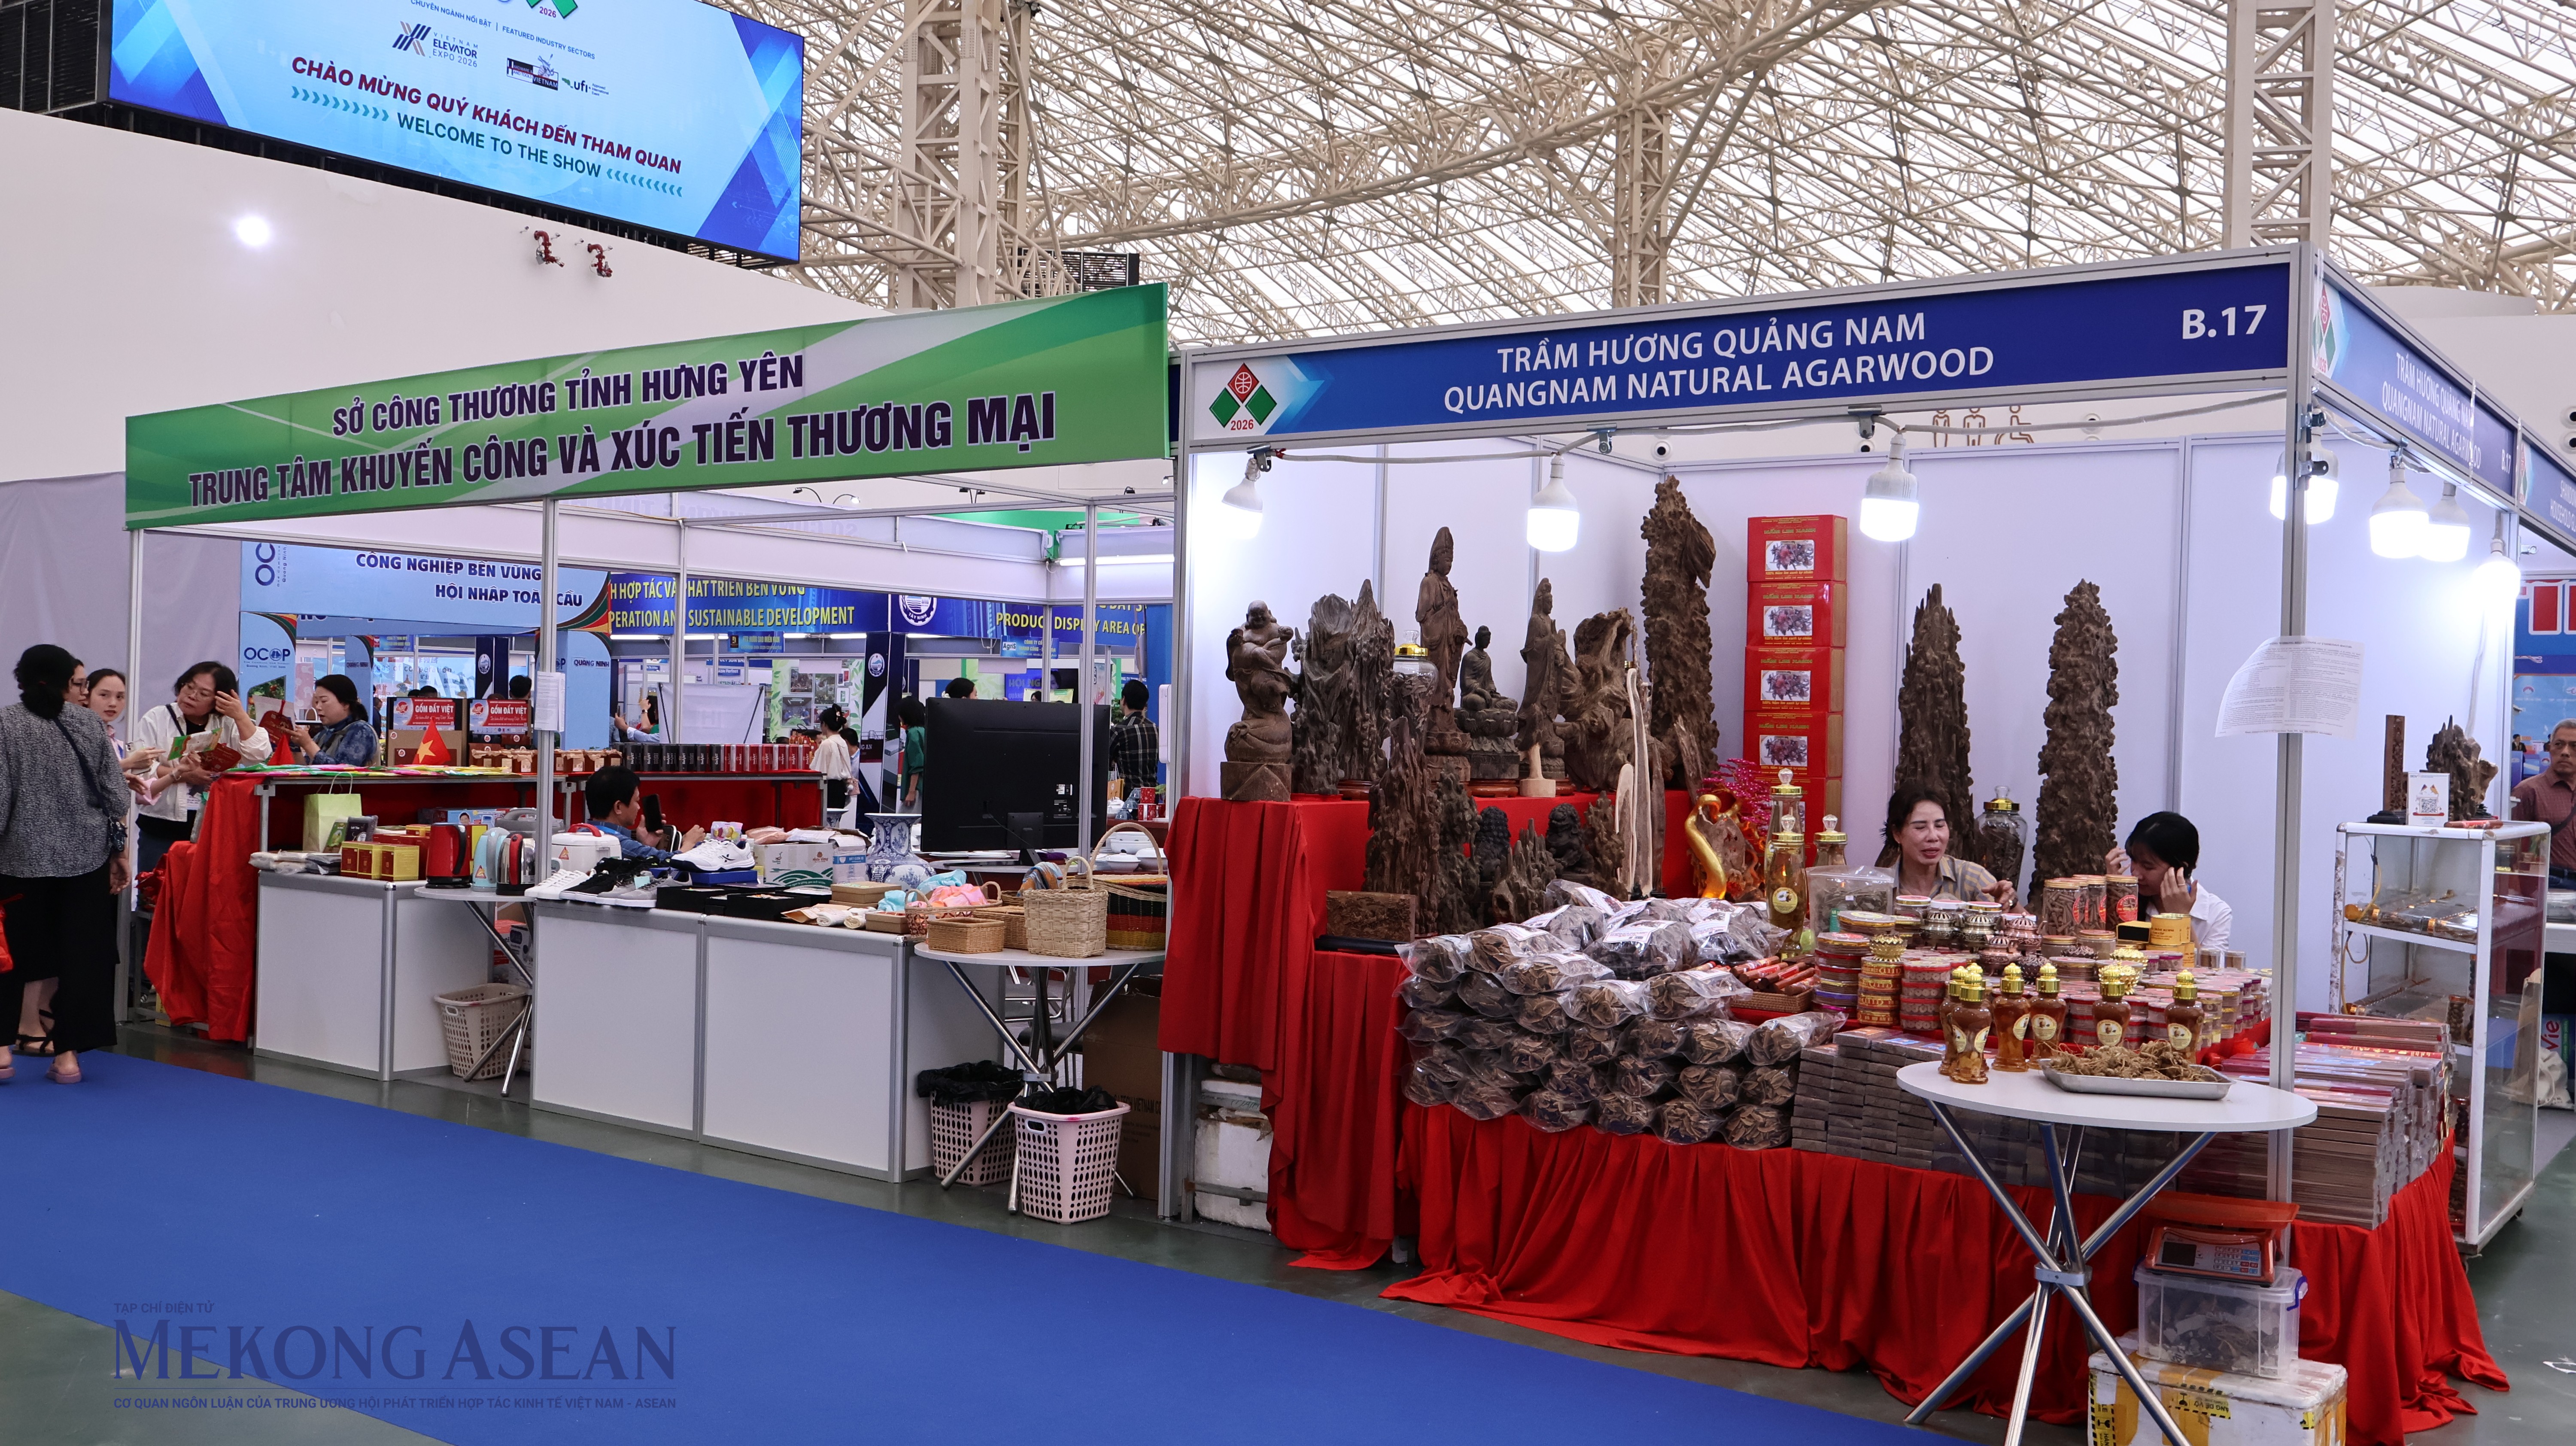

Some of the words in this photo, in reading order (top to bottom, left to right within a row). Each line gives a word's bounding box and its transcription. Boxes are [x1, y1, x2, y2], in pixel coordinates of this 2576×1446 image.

[440, 6, 465, 21] NGÀNH
[539, 6, 557, 18] 2026
[433, 38, 477, 59] ELEVATOR
[502, 26, 535, 42] FEATURED
[535, 34, 566, 50] INDUSTRY
[567, 45, 595, 60] SECTORS
[432, 48, 455, 61] EXPO
[457, 55, 477, 67] 2026
[533, 76, 558, 89] VIETNAM
[292, 57, 353, 86] CHÀO
[358, 74, 422, 104] MỪNG
[427, 94, 469, 116] QUÝ
[472, 104, 539, 136] KHÁCH
[541, 124, 577, 146] ĐẾN
[581, 134, 632, 161] THAM
[635, 149, 681, 174] QUAN
[398, 112, 484, 148] WELCOME
[490, 136, 512, 155] TO
[518, 143, 548, 164] THE
[553, 153, 601, 178] SHOW
[2183, 304, 2267, 339] B.17
[1498, 337, 1577, 373] TRẦM
[1589, 333, 1702, 366] HƯƠNG
[1713, 317, 1833, 359] QUẢNG
[1846, 312, 1925, 346] NAM
[333, 396, 365, 436] SỞ
[372, 394, 440, 432] CÔNG
[448, 382, 556, 422] THƯƠNG
[565, 368, 632, 410] TỈNH
[642, 362, 728, 403] HƯNG
[738, 350, 803, 392] YÊN
[1445, 375, 1617, 414] QUANGNAM
[1628, 364, 1772, 400] NATURAL
[1782, 346, 1994, 389] AGARWOOD
[2417, 368, 2439, 407] HƯƠNG
[1230, 419, 1254, 431] 2026
[2383, 380, 2422, 431] QUANGNAM
[2423, 409, 2450, 450] NATURAL
[189, 466, 269, 507] TRUNG
[276, 455, 332, 500] TÂM
[341, 437, 453, 495] KHUYẾN
[462, 433, 548, 483] CÔNG
[558, 425, 601, 474] VÀ
[611, 420, 680, 471] XÚC
[692, 407, 775, 465] TIẾN
[786, 401, 953, 459] THƯƠNG
[967, 391, 1056, 454] MẠI
[2501, 449, 2512, 474] B.17
[356, 551, 401, 570] CÔNG
[407, 558, 464, 576] NGHIỆP
[500, 565, 541, 580] VỮNG
[435, 582, 463, 600] HỘI
[468, 585, 509, 603] NHẬP
[512, 589, 541, 605] TOÀ
[557, 589, 583, 607] CẦU
[620, 580, 642, 604] HỢP
[644, 577, 663, 599] TÁC
[662, 610, 676, 627] AN
[688, 608, 764, 627] SUSTAINABLE
[766, 606, 855, 627] DEVELOPMENT
[996, 612, 1045, 629] PRODUC
[1054, 616, 1100, 633] DISPLY
[1102, 620, 1130, 635] AREA
[415, 702, 428, 713] GỐM
[429, 702, 440, 713] ĐẤT
[440, 705, 454, 715] VIỆT
[490, 704, 503, 714] GỐM
[503, 702, 514, 714] ĐẤT
[515, 706, 528, 717] VIỆT
